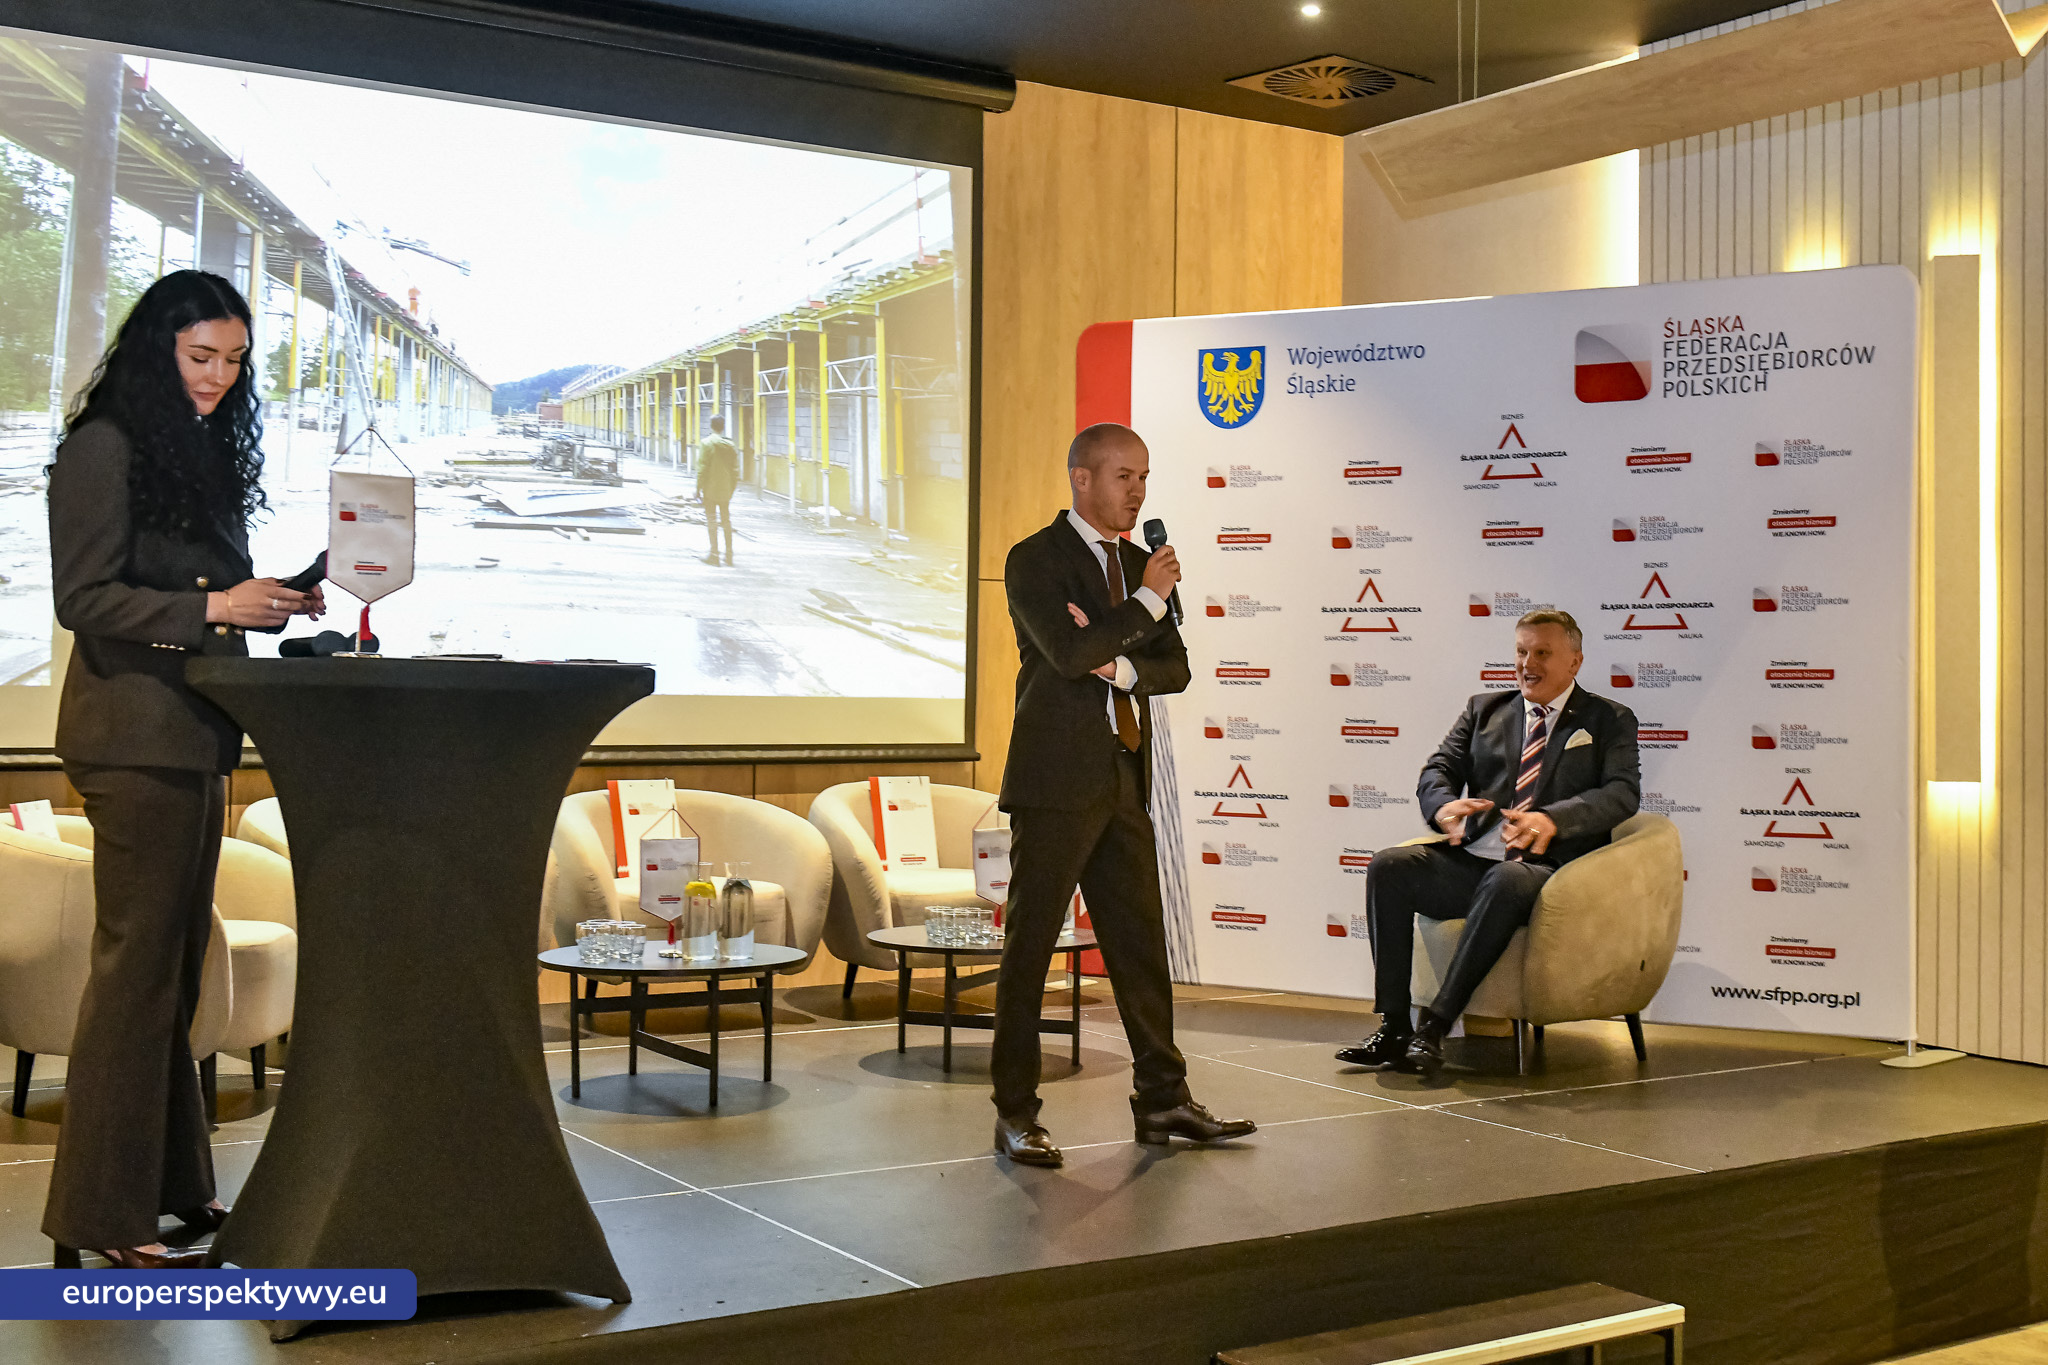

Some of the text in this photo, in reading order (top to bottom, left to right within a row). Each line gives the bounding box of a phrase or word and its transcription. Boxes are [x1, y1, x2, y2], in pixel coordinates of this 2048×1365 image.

[1664, 315, 1744, 339] ŚLĄSKA
[1288, 342, 1425, 368] Województwo
[1664, 331, 1788, 358] FEDERACJA
[1664, 342, 1875, 378] PRZEDSIĘBIORCÓW
[1287, 374, 1356, 398] Śląskie
[1664, 375, 1767, 398] POLSKICH
[1512, 451, 1567, 459] GOSPODARCZA
[1798, 810, 1860, 818] GOSPODARCZA
[1712, 987, 1860, 1009] www.sfpp.org.pl
